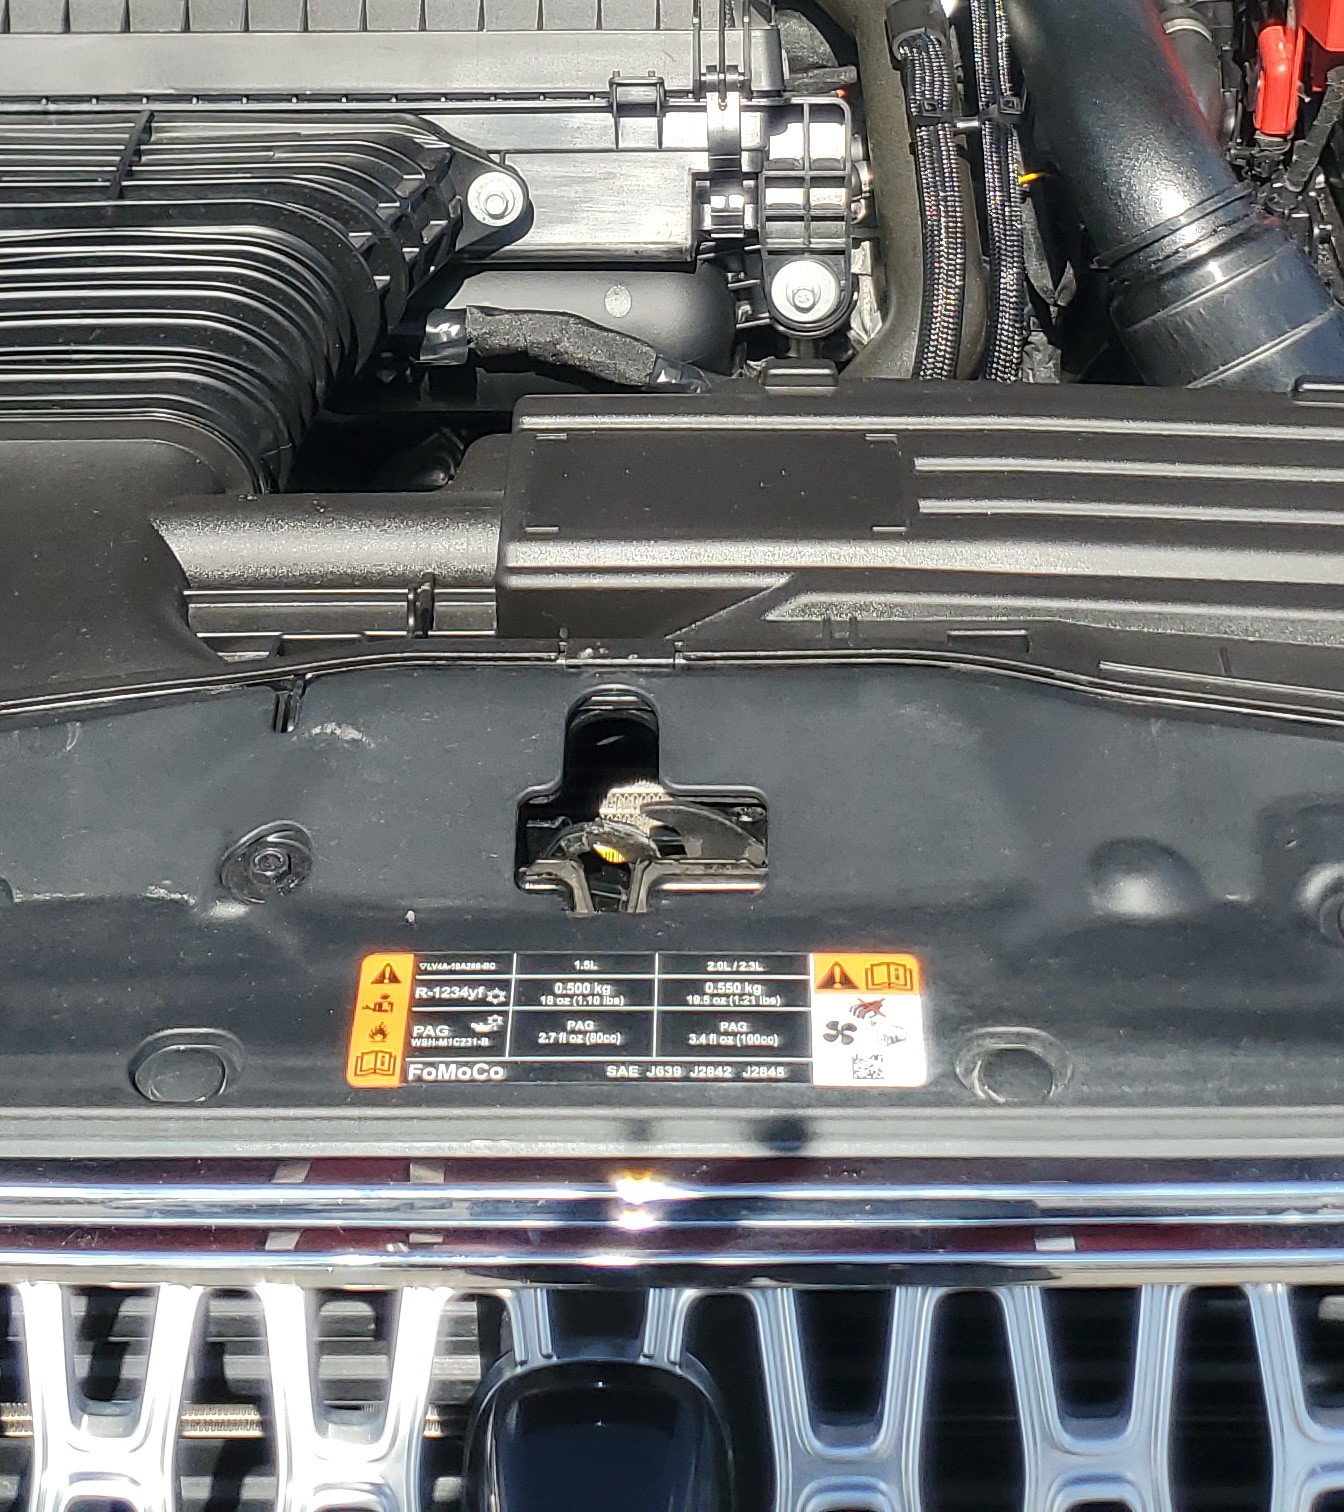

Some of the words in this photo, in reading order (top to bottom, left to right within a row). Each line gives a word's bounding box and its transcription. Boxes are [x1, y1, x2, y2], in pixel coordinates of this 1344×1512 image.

[574, 960, 599, 970] 1.5L
[707, 961, 731, 972] 2.0L
[738, 961, 765, 972] 2.3L
[415, 985, 486, 1002] R-1234yf
[554, 982, 591, 995] 0.500
[593, 982, 612, 996] kg
[704, 982, 742, 994] 0.550
[743, 981, 763, 996] kg
[556, 997, 571, 1006] oz
[572, 995, 601, 1007] (1.10
[602, 995, 625, 1007] lbs)
[712, 996, 728, 1006] oz
[729, 995, 756, 1007] (1.21
[758, 995, 781, 1007] lbs)
[412, 1024, 451, 1037] PAG
[566, 1020, 596, 1031] PAG
[719, 1021, 749, 1033] PAG
[537, 1032, 556, 1044] 2.7
[558, 1031, 568, 1044] fl
[569, 1034, 585, 1044] oz
[585, 1032, 622, 1046] (80cc)
[688, 1033, 707, 1045] 3.4
[708, 1033, 718, 1045] fl
[718, 1036, 734, 1045] oz
[736, 1033, 779, 1047] (100cc)
[407, 1062, 505, 1082] FoMoCo
[606, 1065, 640, 1078] SAE
[646, 1065, 683, 1078] J639
[689, 1065, 733, 1078] J2842
[742, 1065, 786, 1078] J2845
